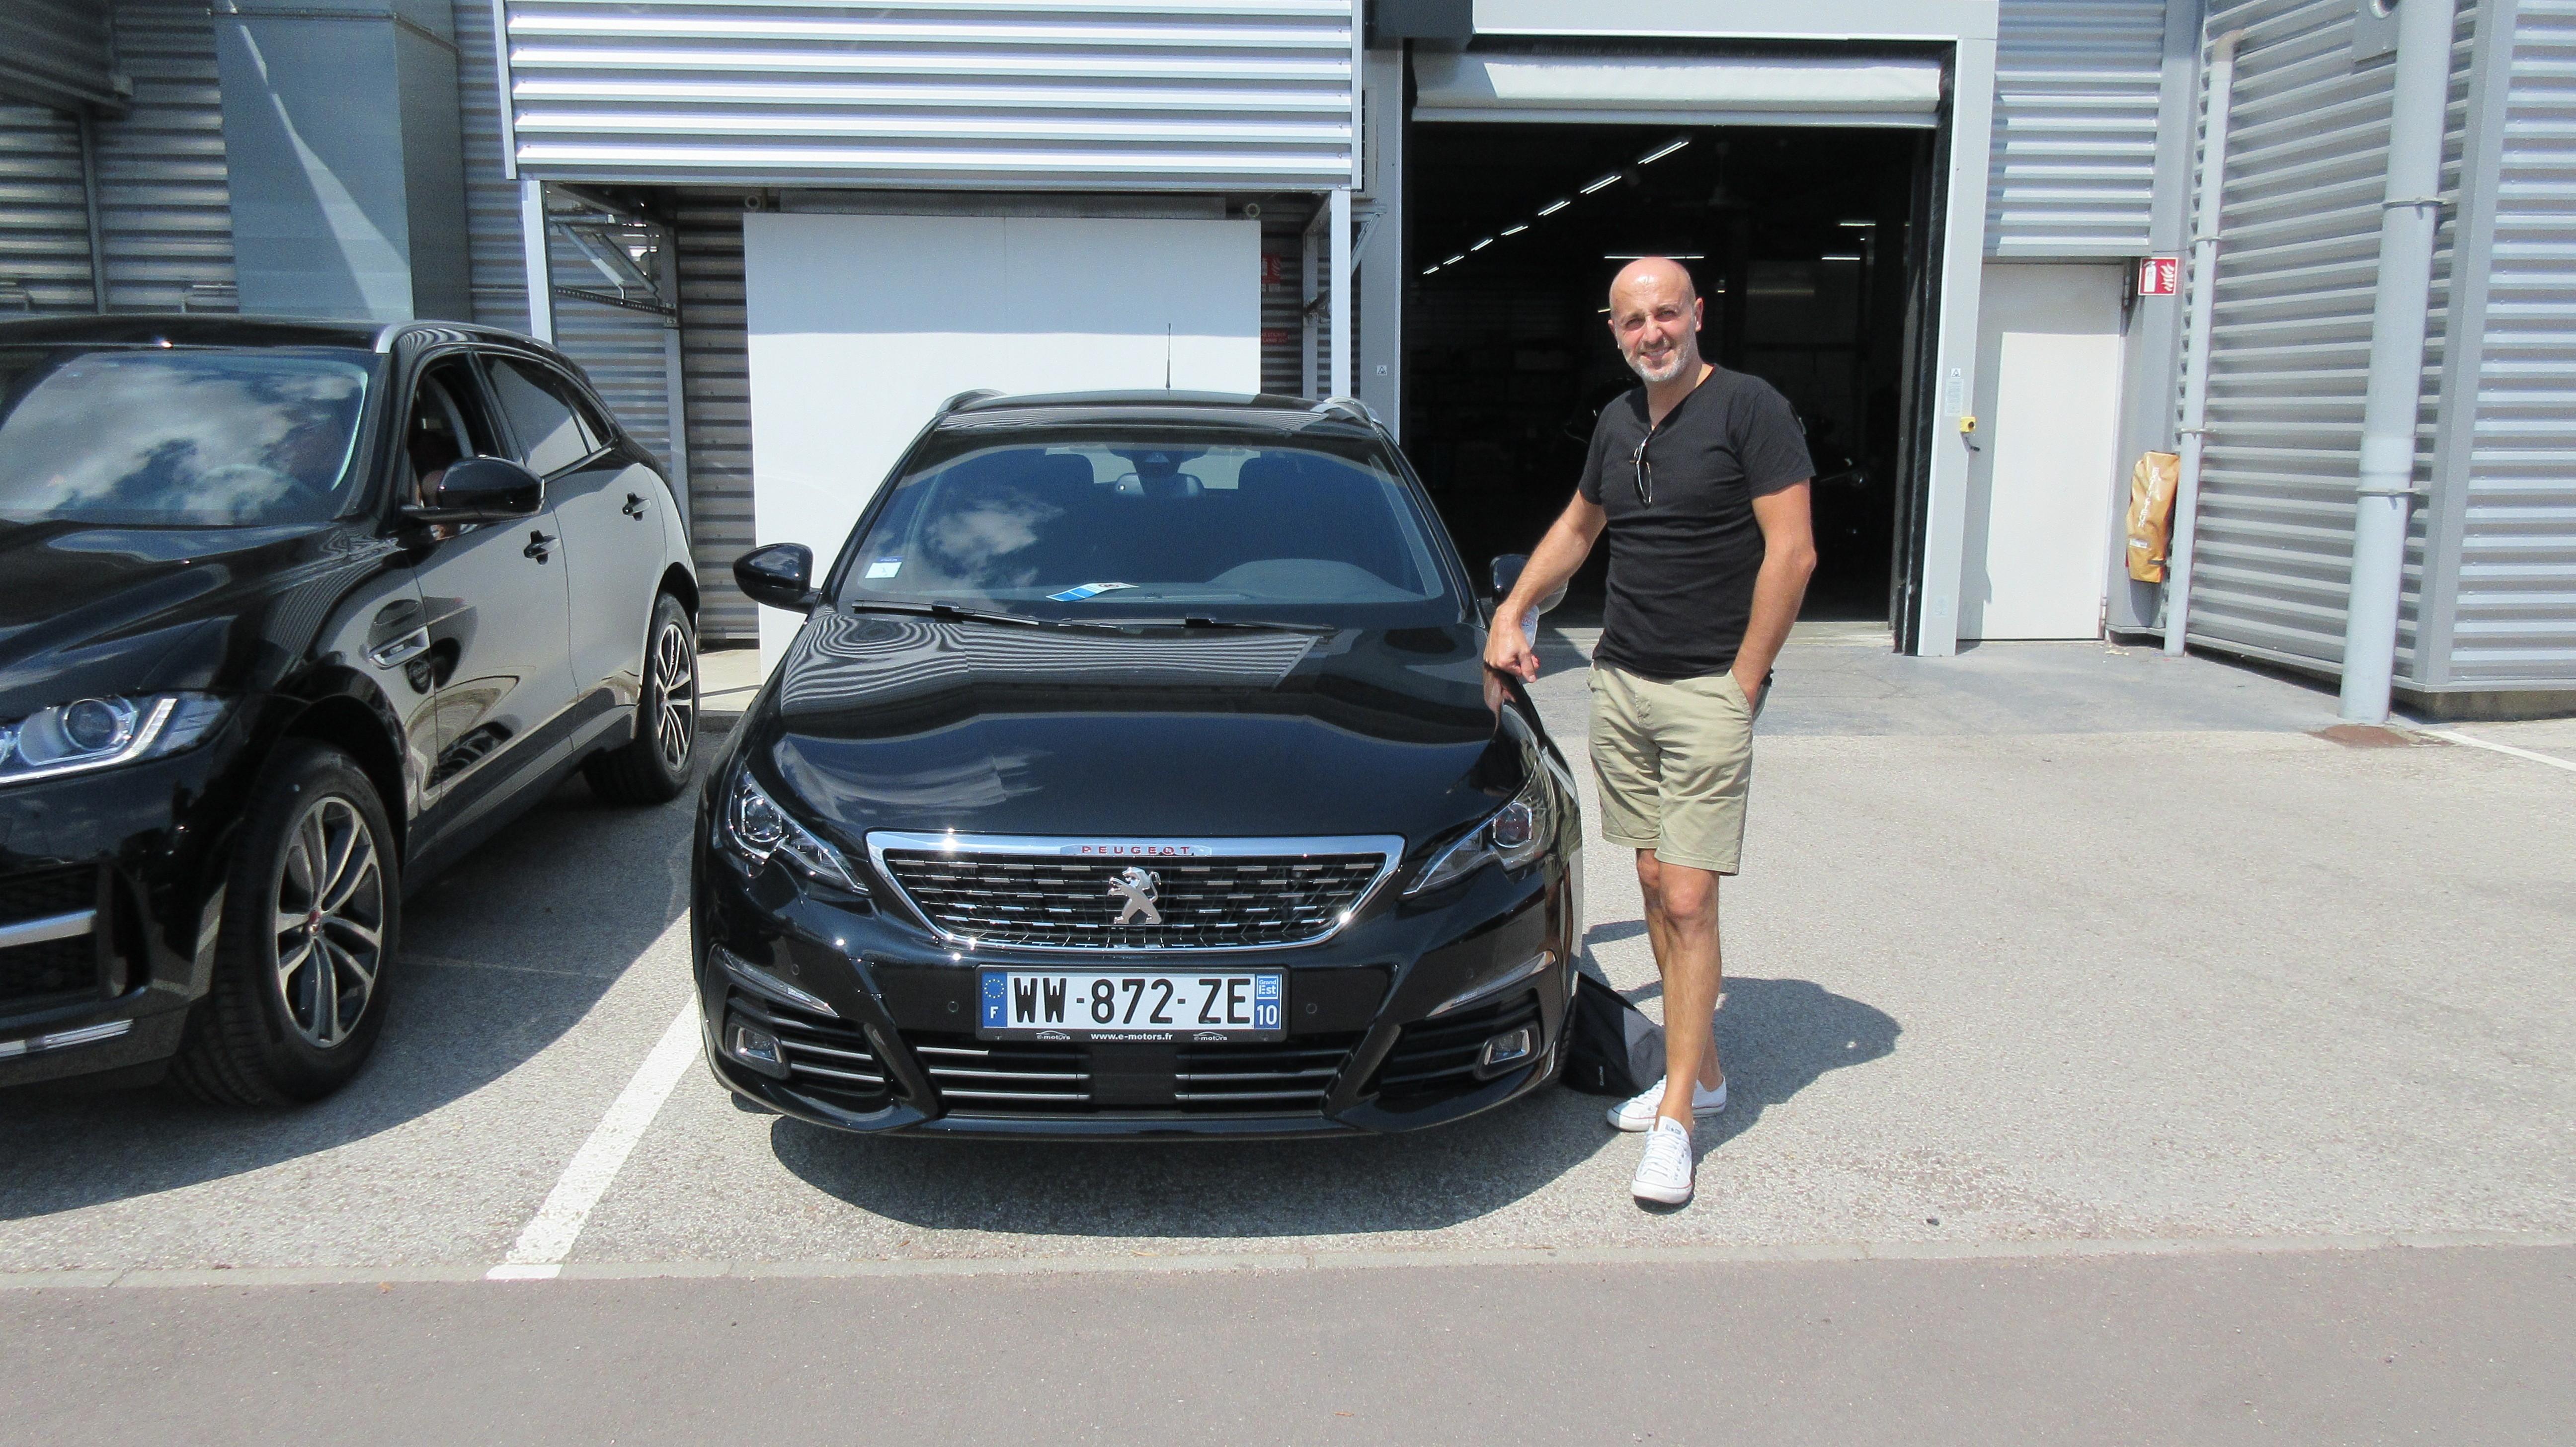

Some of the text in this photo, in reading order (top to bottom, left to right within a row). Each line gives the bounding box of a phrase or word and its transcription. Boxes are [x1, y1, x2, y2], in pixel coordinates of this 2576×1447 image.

[1259, 985, 1276, 994] Est
[1014, 977, 1250, 1024] WW-872-ZE
[990, 1006, 998, 1019] F
[1257, 1005, 1277, 1025] 10
